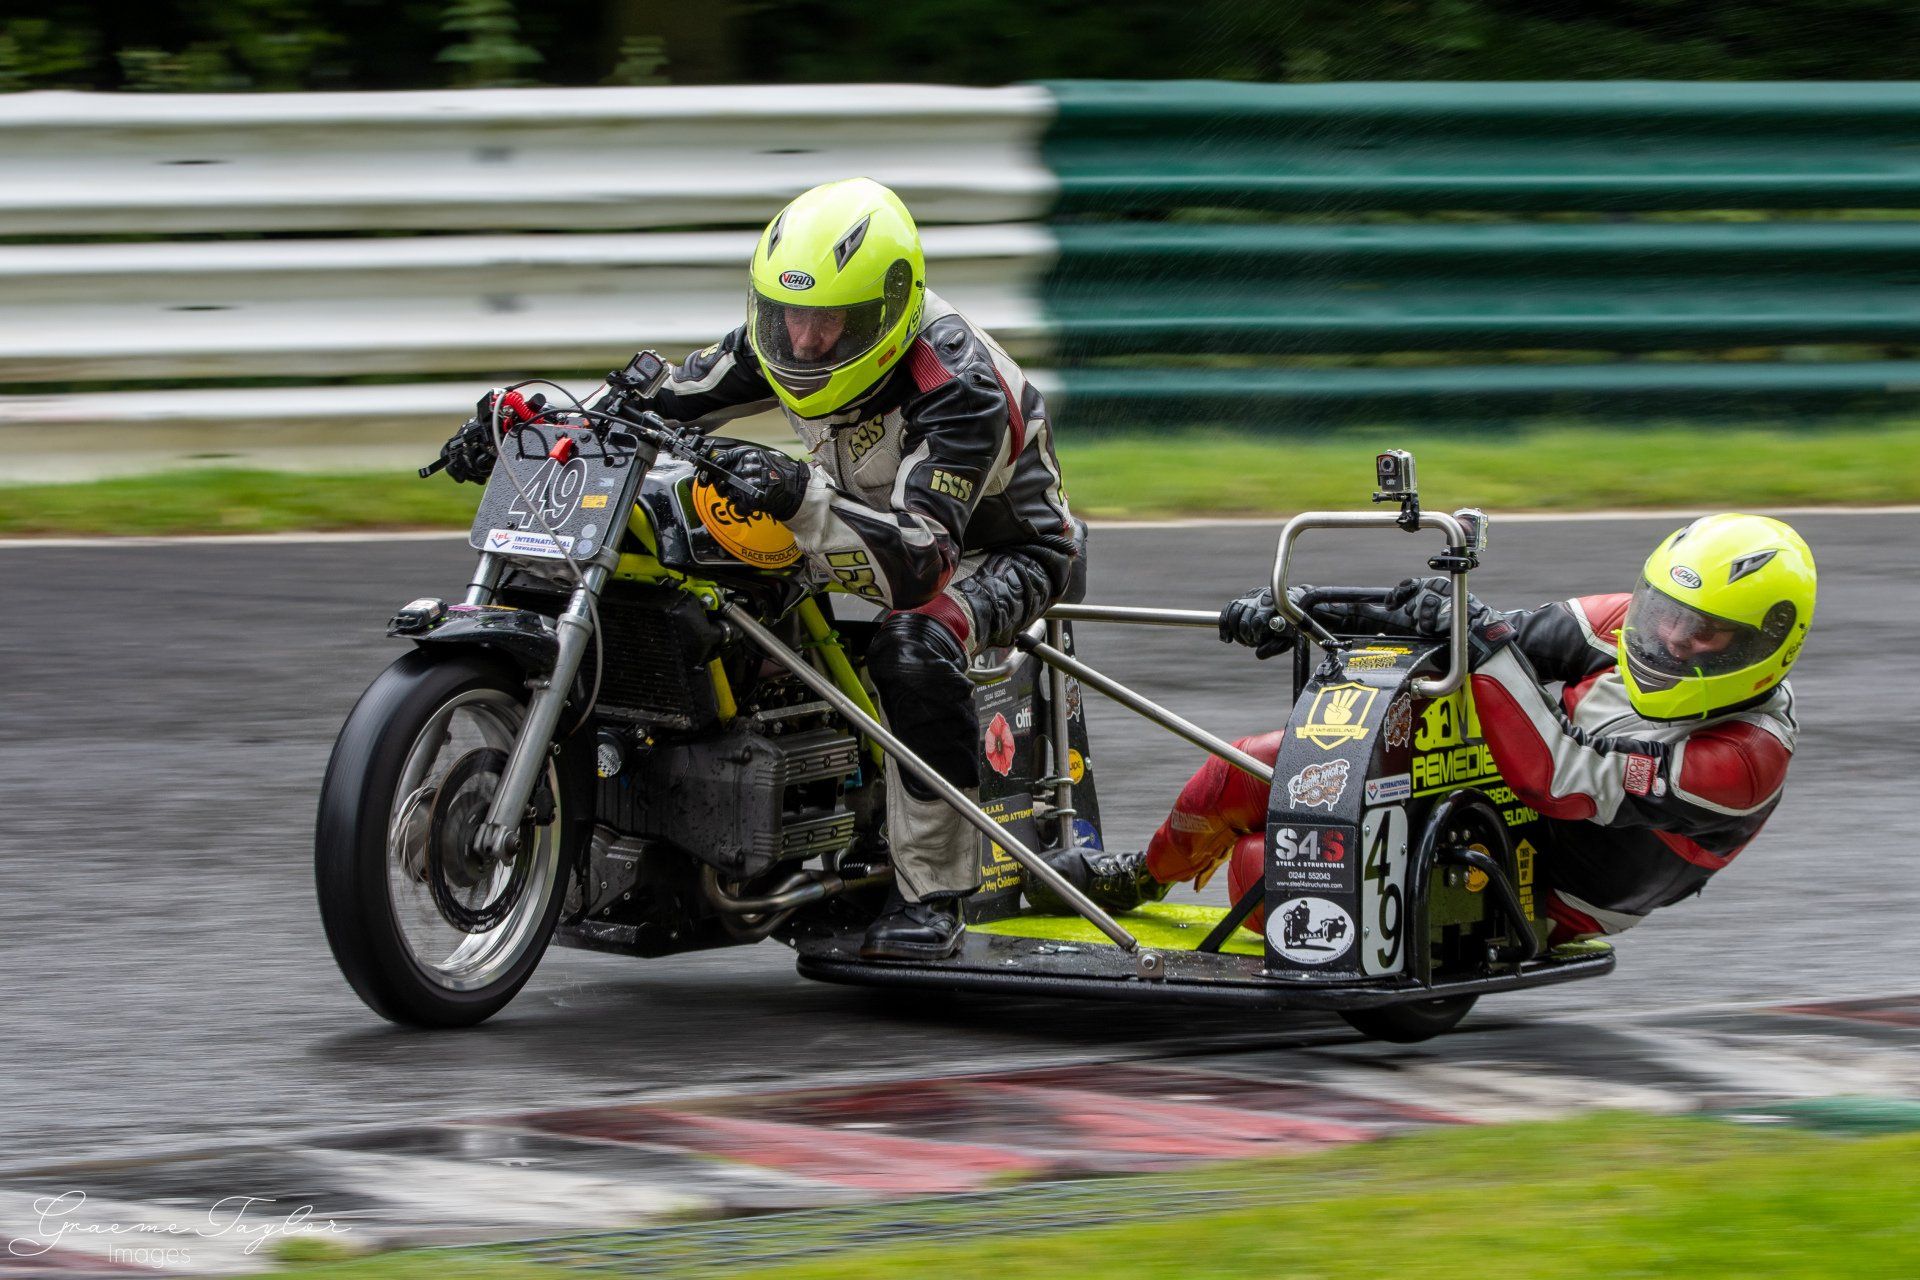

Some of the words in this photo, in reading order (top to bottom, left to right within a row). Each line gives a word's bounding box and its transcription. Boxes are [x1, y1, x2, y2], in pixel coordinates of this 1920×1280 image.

[508, 457, 587, 531] 49
[514, 535, 571, 548] INTERNATIOAL
[741, 548, 764, 561] RACE
[1412, 744, 1498, 790] REMEDIE
[1380, 778, 1410, 789] INTERNATIONAL
[1010, 808, 1034, 822] ATTEMPT
[1503, 807, 1539, 827] ELDING
[1275, 828, 1345, 862] S4S
[982, 864, 1001, 877] Raising
[1001, 862, 1018, 873] money
[1288, 871, 1306, 879] 01244
[1308, 871, 1331, 880] 552043
